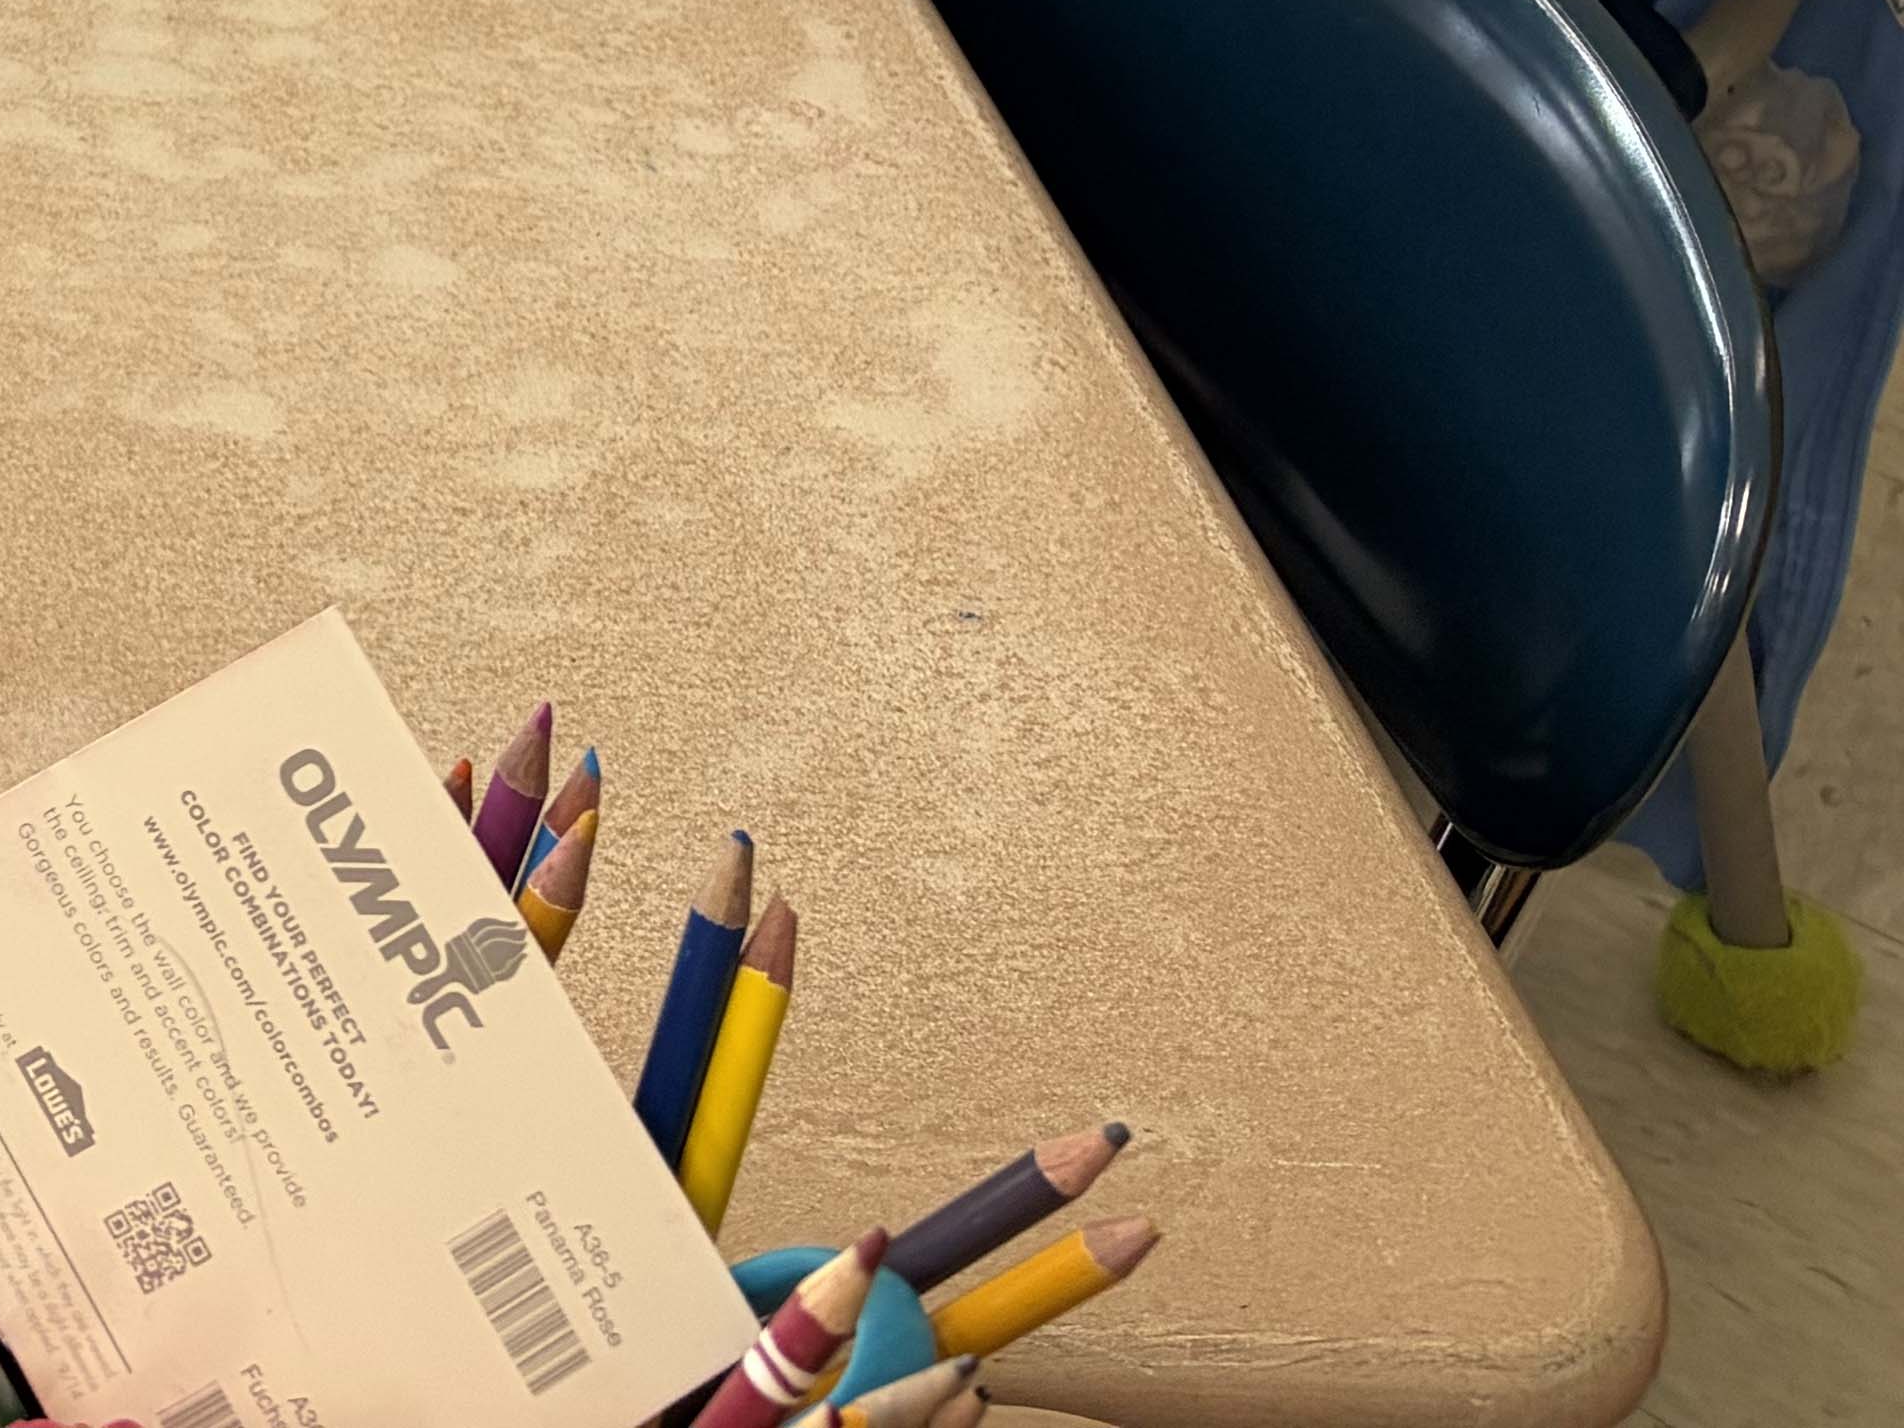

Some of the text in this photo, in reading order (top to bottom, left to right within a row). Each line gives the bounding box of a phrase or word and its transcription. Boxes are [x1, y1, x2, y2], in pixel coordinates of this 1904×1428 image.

[1, 1032, 17, 1048] at
[17, 821, 256, 1230] Gorgeous colors and results. Guaranteed.
[42, 806, 67, 841] the
[104, 914, 134, 958] trim
[129, 962, 163, 1000] and
[153, 1004, 202, 1072] accent
[64, 793, 306, 1208] You choose the wall color and we provide
[143, 815, 338, 1143] www.olympic.com/colorcombos
[180, 789, 379, 1118] COLOR COMBINATIONS TODAY!
[231, 831, 366, 1044] FIND YOUR PERFECT
[278, 747, 484, 1050] OLYMPIC
[525, 1189, 622, 1347] Panama Rose
